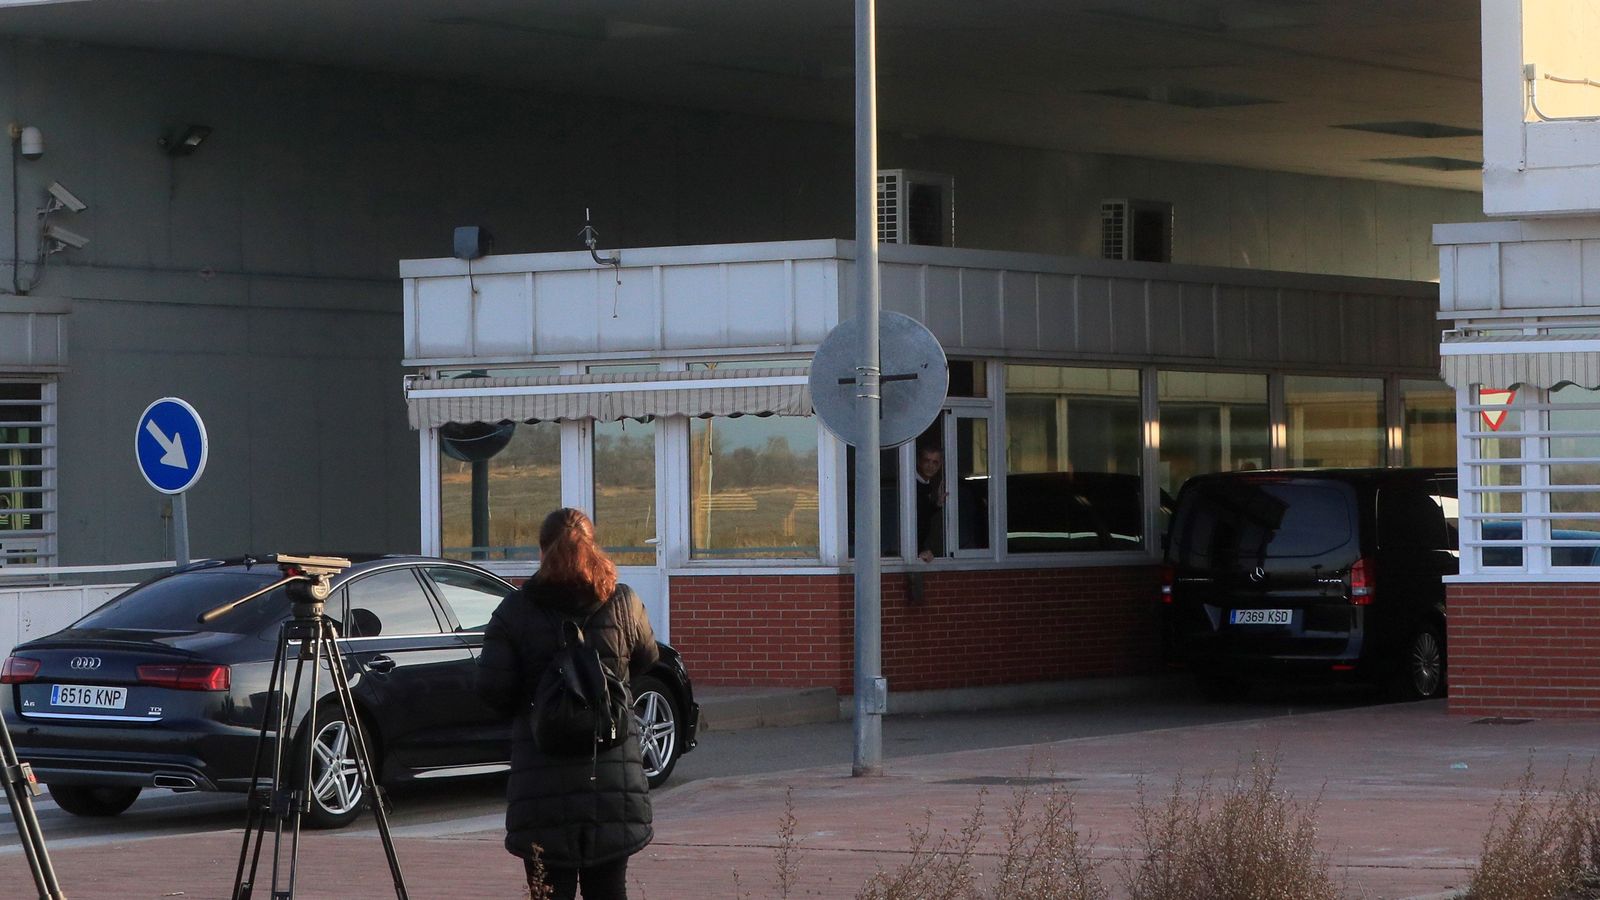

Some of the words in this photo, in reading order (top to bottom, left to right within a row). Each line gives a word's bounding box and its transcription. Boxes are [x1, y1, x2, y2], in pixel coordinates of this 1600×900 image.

[1239, 611, 1264, 622] 7369
[1267, 611, 1288, 622] KSD
[60, 687, 91, 705] 6516
[95, 689, 121, 706] KNP
